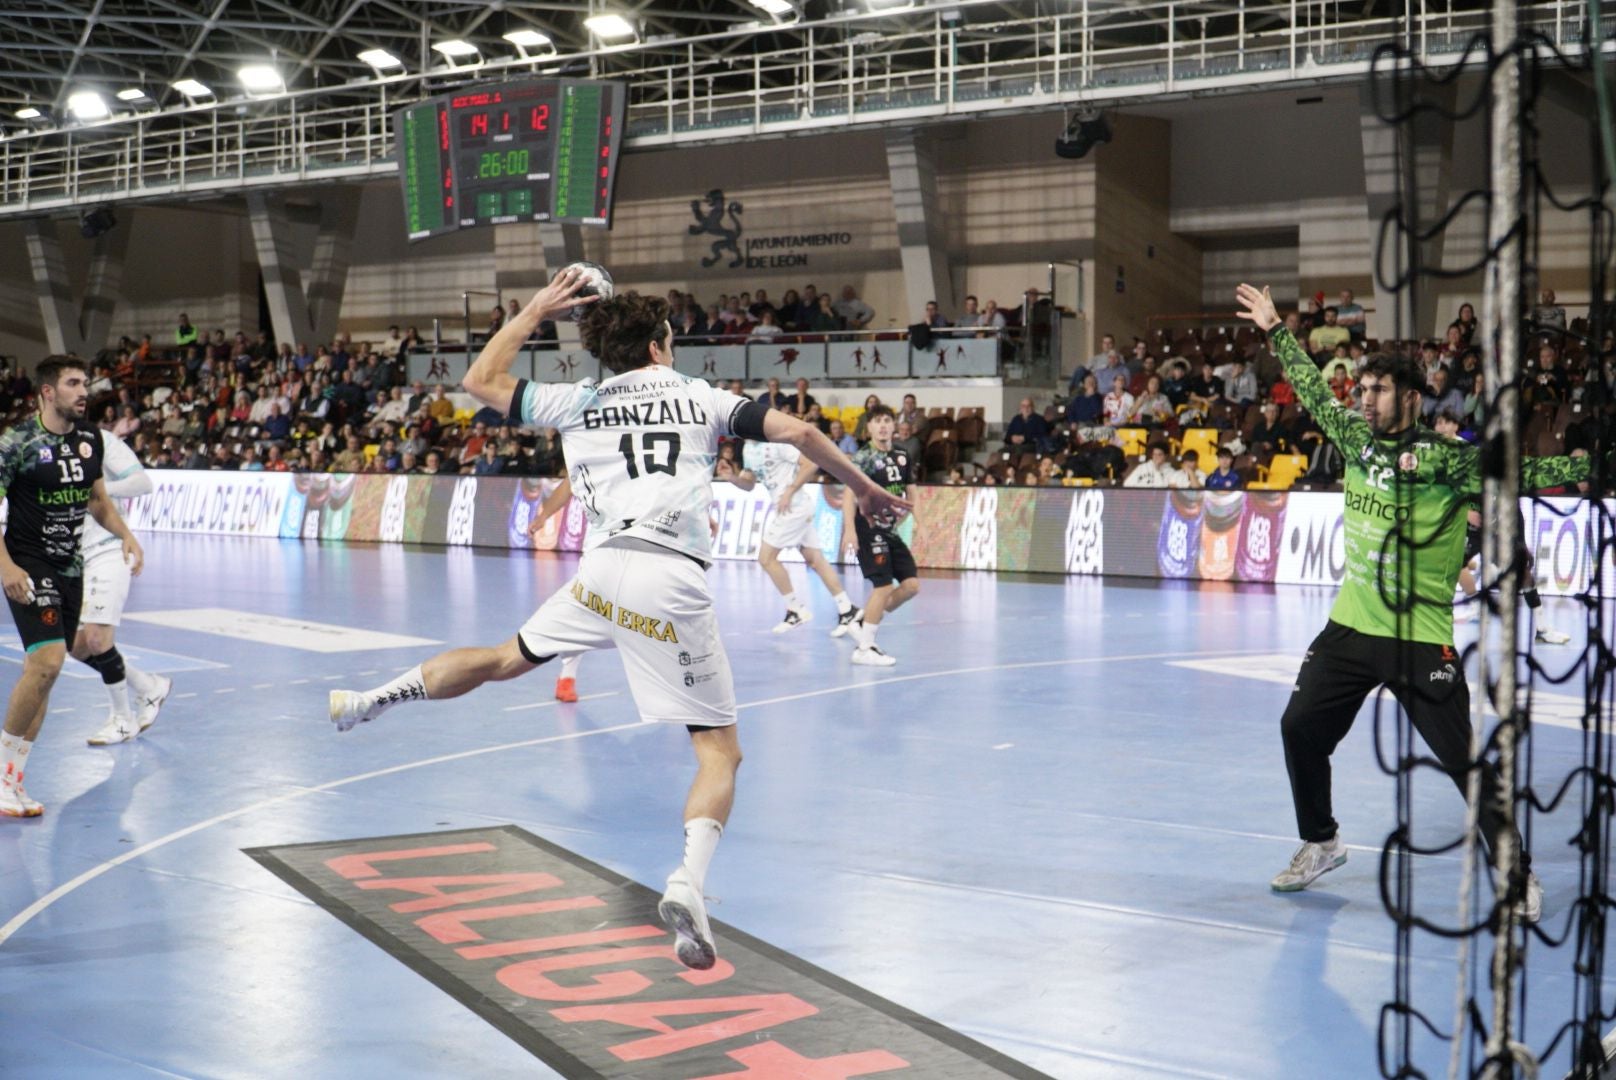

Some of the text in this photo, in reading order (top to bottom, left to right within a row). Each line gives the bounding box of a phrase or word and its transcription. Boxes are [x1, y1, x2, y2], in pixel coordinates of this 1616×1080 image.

[471, 113, 487, 136] 14
[503, 112, 510, 130] 1
[531, 104, 549, 130] 12
[479, 150, 529, 178] 26:00
[751, 233, 852, 250] AYUNTAMIENTO
[750, 256, 767, 269] DE
[596, 382, 648, 397] CASTILLA
[648, 382, 658, 391] Y
[57, 458, 84, 483] 15
[886, 465, 902, 481] 21
[1345, 482, 1410, 521] bathco
